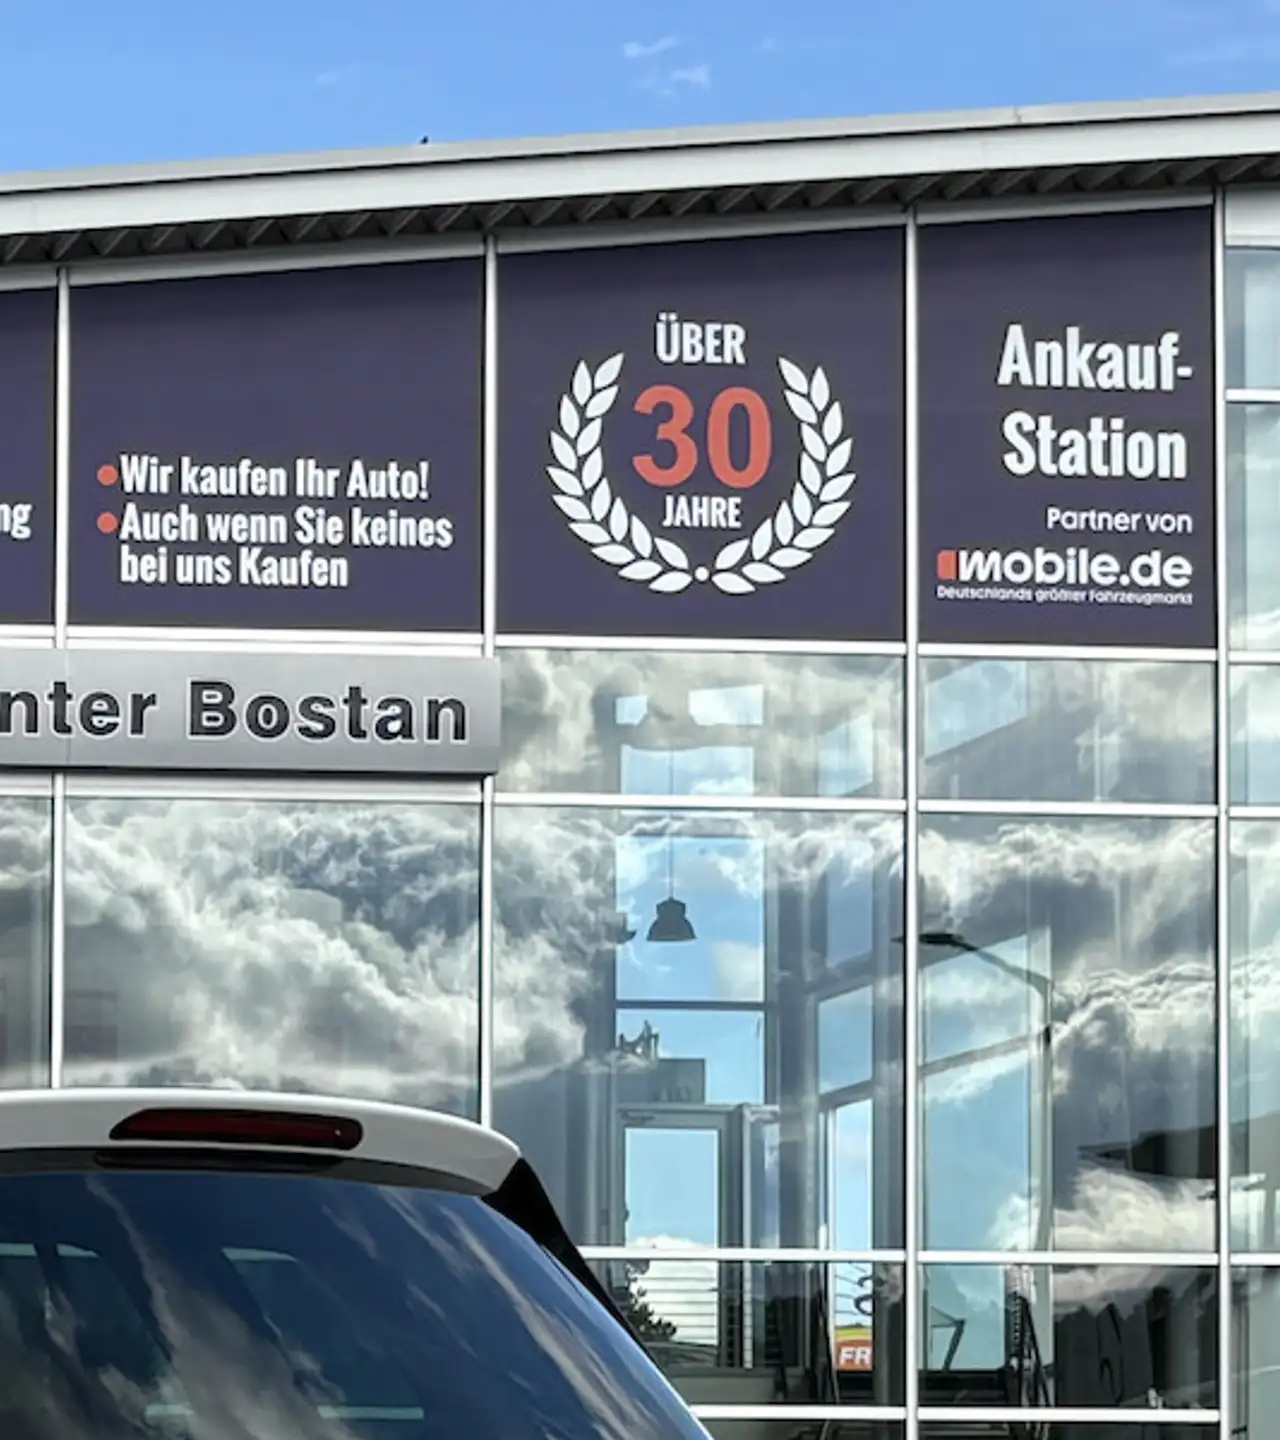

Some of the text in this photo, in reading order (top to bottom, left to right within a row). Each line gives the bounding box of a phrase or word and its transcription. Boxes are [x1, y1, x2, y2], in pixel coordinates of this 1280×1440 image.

[656, 312, 746, 365] ÜBER
[997, 324, 1193, 391] Ankauf-
[632, 384, 773, 488] 30
[1003, 410, 1187, 479] Station
[120, 454, 429, 500] Wir kaufen Ihr Auto!
[119, 501, 453, 548] Auch wenn Sie keines
[662, 494, 742, 529] JAHRE
[1047, 507, 1193, 534] Partner von
[120, 543, 349, 587] bei uns Kaufen
[958, 546, 1193, 588] mobile.de
[186, 679, 470, 742] Bostan
